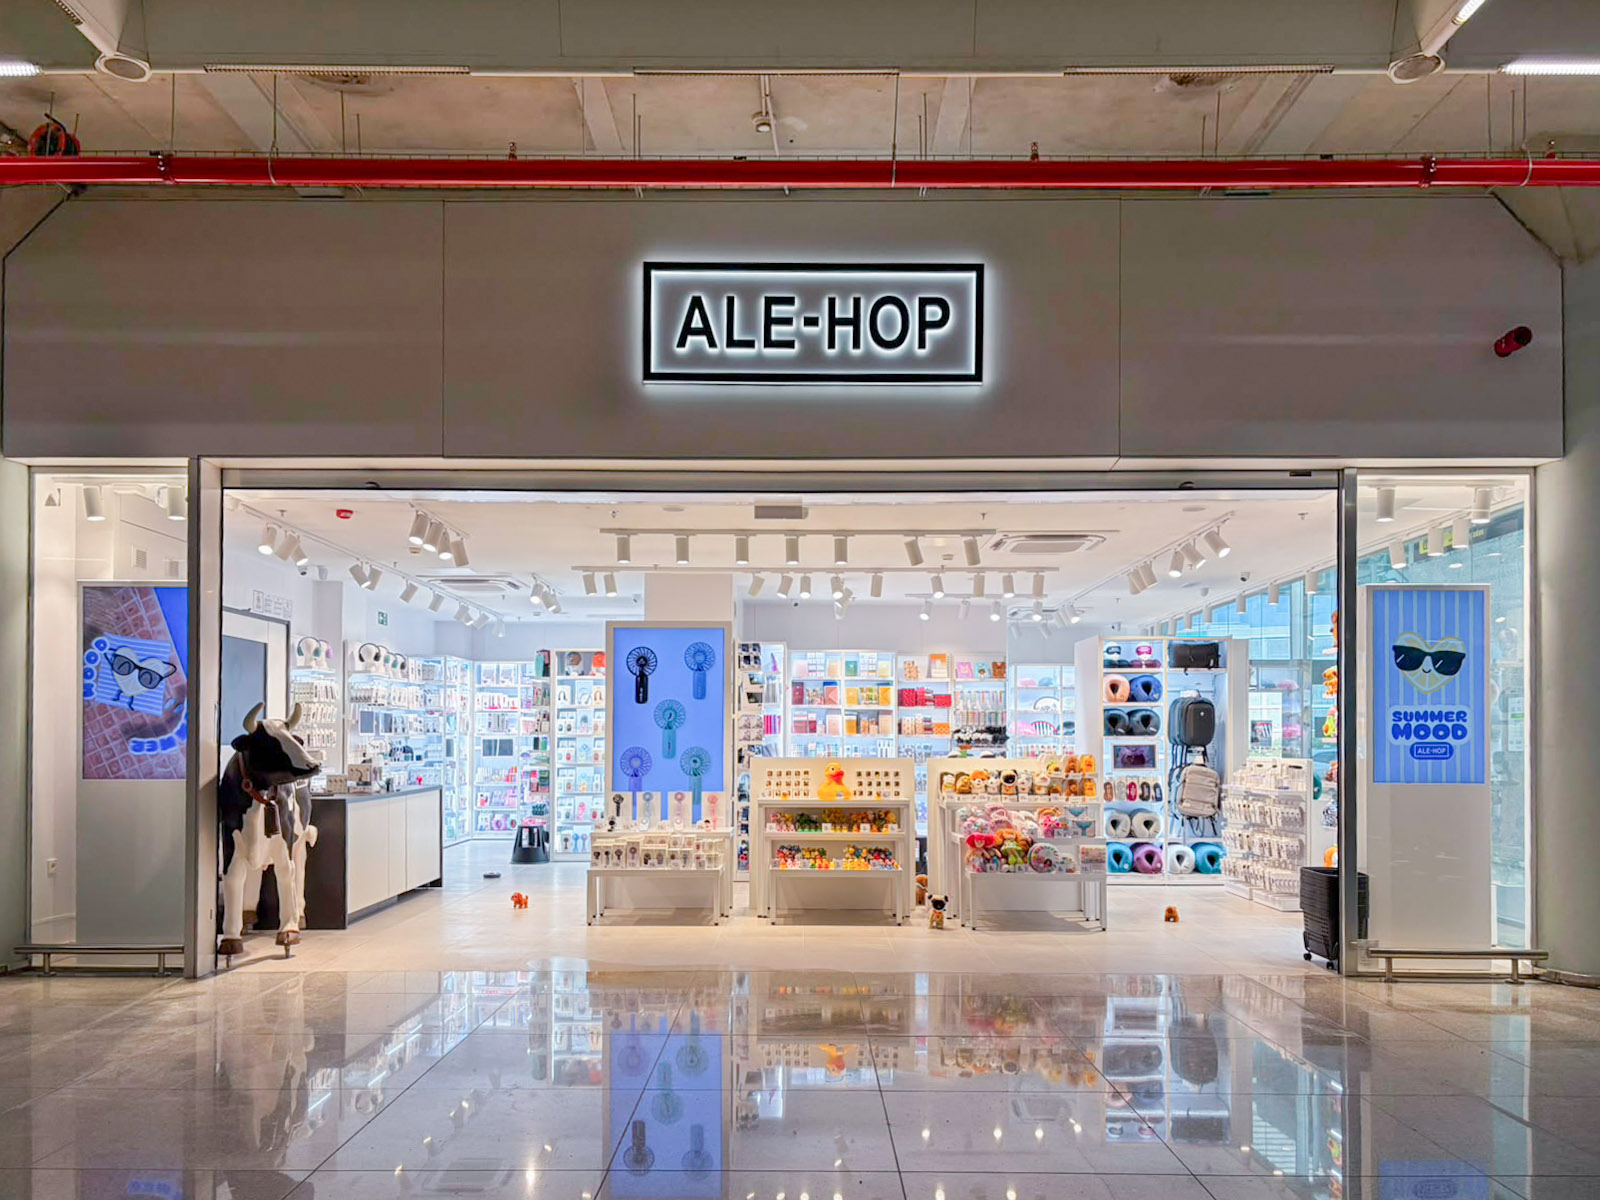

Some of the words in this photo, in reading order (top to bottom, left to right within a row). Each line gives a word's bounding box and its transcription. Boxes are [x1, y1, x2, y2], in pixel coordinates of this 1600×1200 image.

[676, 295, 950, 350] ALE-HOP
[1392, 710, 1467, 722] SUMMER
[1391, 723, 1468, 740] MOOD
